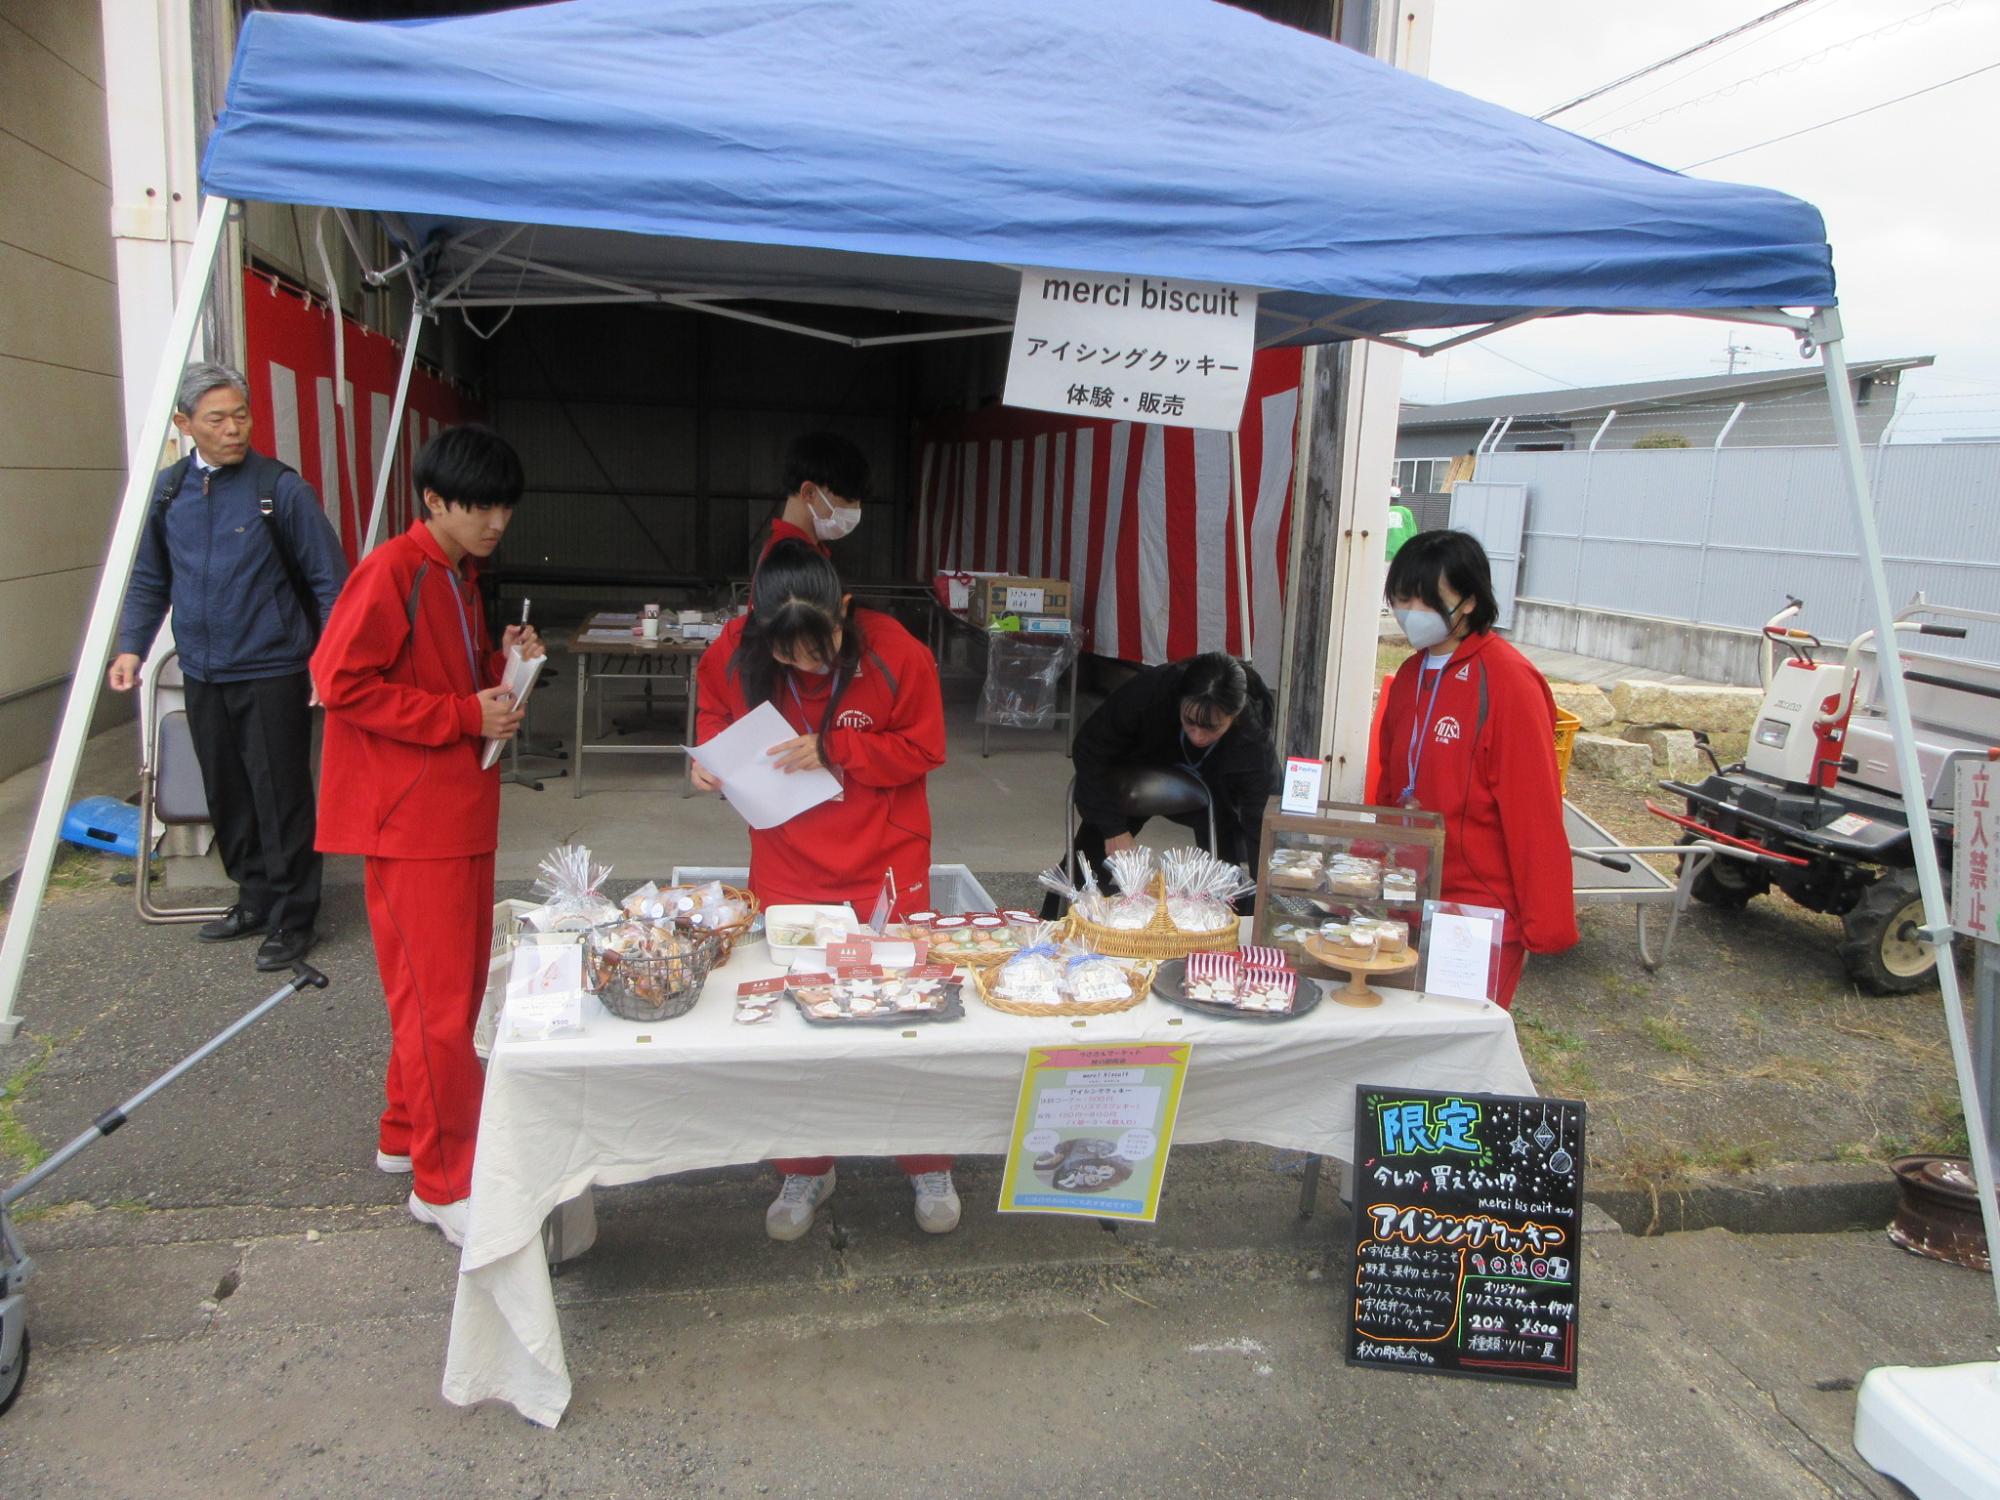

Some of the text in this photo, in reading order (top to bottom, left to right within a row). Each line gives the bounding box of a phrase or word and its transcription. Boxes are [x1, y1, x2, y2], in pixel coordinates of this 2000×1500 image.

[1042, 278, 1239, 317] merci biscuit
[1027, 337, 1239, 376] アイシングクッキー
[1066, 383, 1186, 417] 体験・販売
[1968, 772, 1990, 932] 立入禁止
[1381, 1099, 1479, 1153] 限定
[1371, 1207, 1563, 1250] アイシングクッキー
[1483, 1281, 1528, 1295] オリジナル
